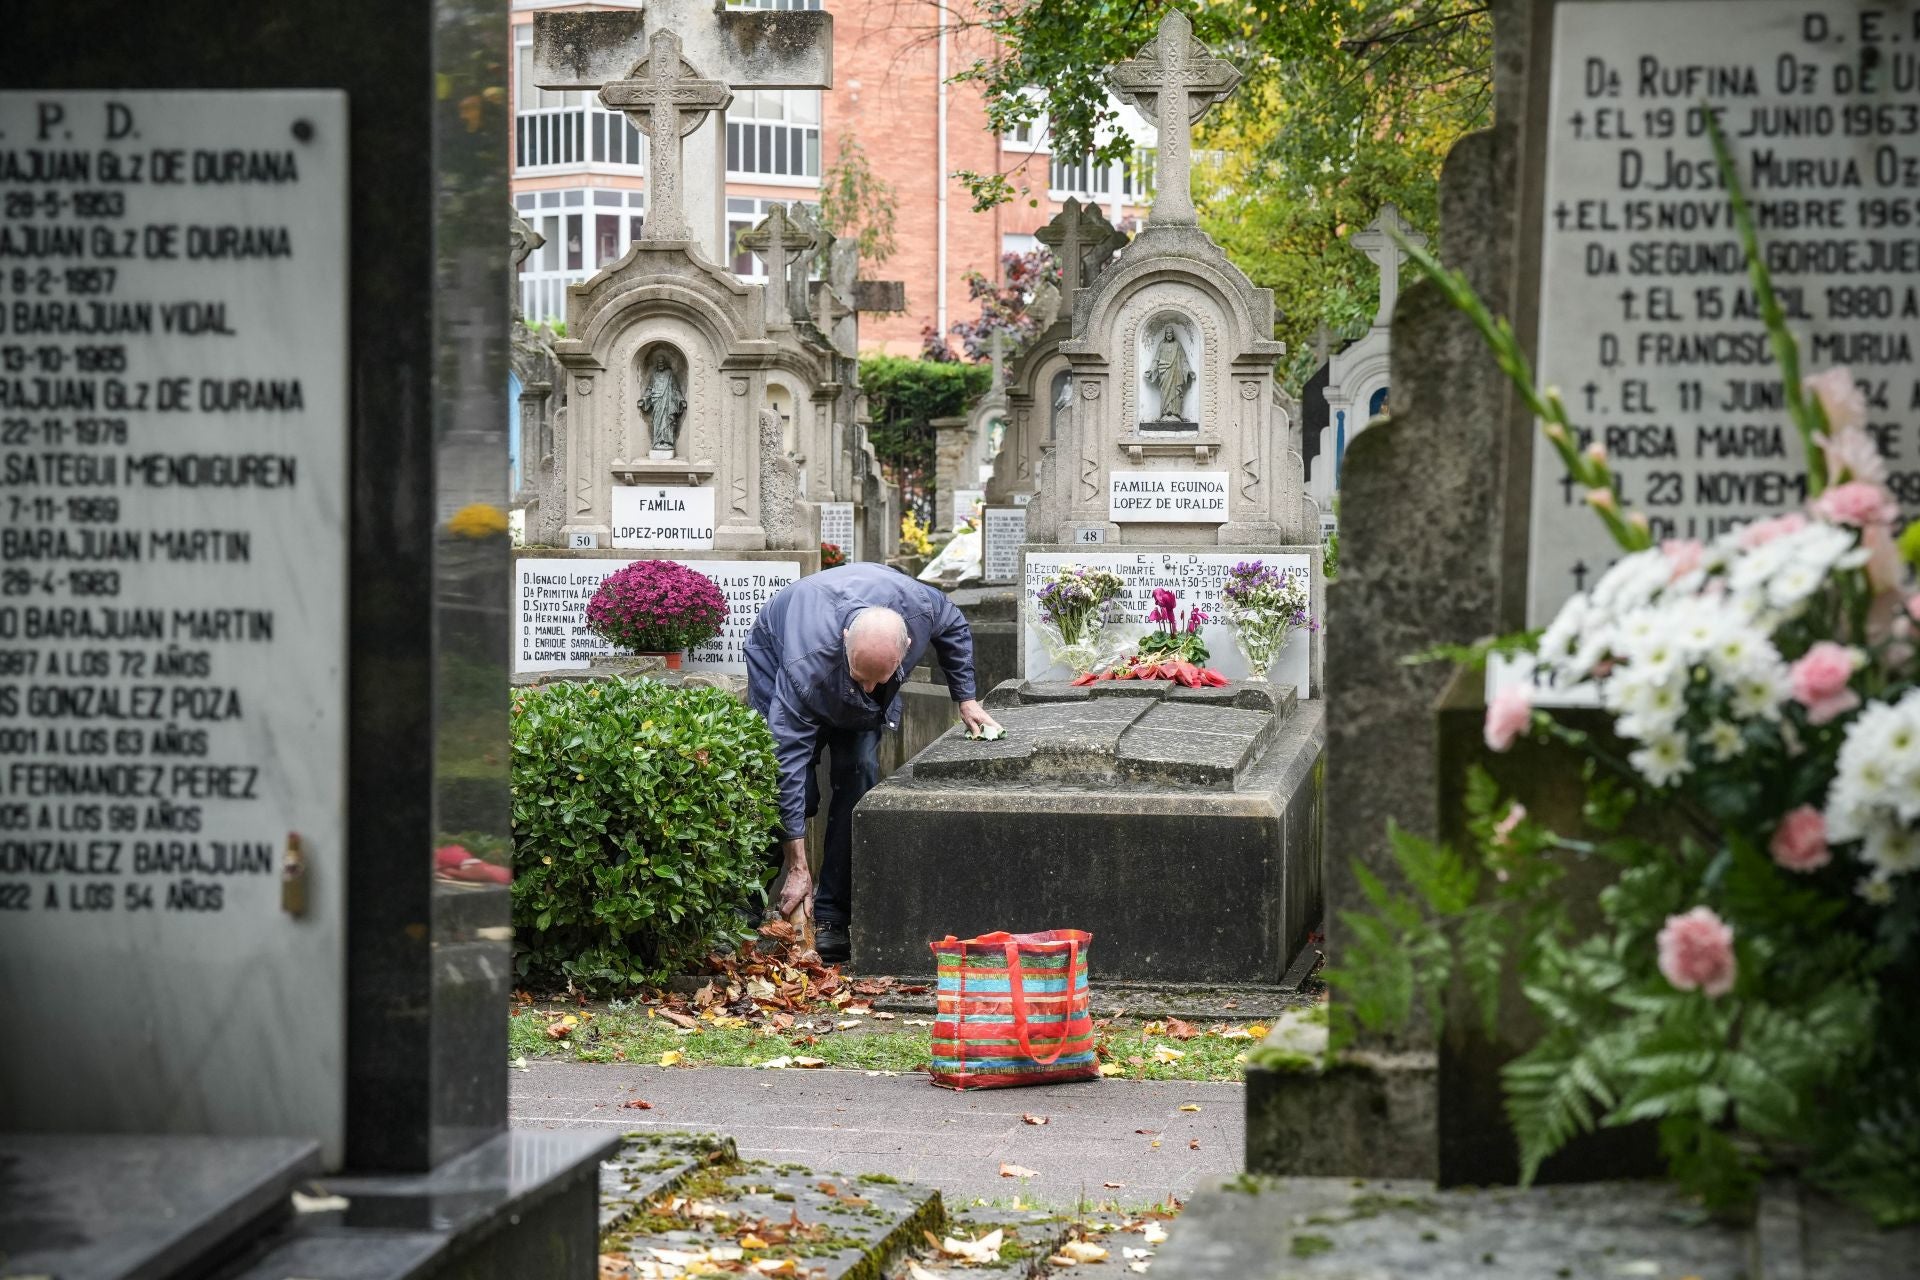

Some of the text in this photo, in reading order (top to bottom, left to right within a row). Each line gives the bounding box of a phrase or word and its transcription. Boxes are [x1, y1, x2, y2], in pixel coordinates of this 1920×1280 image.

[1639, 55, 1760, 98] RUFINA
[37, 102, 140, 141] P. D.
[1595, 108, 1633, 140] EL
[1643, 107, 1675, 139] 19
[1737, 105, 1834, 139] JUNIO
[1841, 103, 1919, 137] 1963
[193, 150, 299, 184] DURANA
[1752, 149, 1862, 190] MURUA
[1657, 200, 1846, 230] NOVIMBRE
[1857, 199, 1920, 230] 196
[186, 225, 293, 261] DURANA
[1767, 240, 1920, 275] GORDEJUE
[12, 301, 152, 336] BARAJUAN
[160, 302, 237, 337] VIDAL
[1695, 287, 1723, 321] 15
[1825, 285, 1893, 320] 1980
[1638, 334, 1776, 365] FRANCISC
[1811, 333, 1913, 365] MURUA
[200, 377, 304, 413] DURANA
[1621, 379, 1786, 414] EL 11 JUNI
[1605, 424, 1678, 460] ROSA
[1696, 424, 1787, 460] MARIA
[1113, 481, 1224, 492] FAMILIA EGUINOA
[1114, 498, 1224, 510] LOPEZ DE URALDE
[1647, 470, 1683, 506] 23
[1696, 471, 1808, 506] NOVIEM
[639, 499, 686, 512] FAMILIA
[1, 528, 251, 563] BARAJUAN MARTIN
[576, 536, 591, 547] 50
[613, 526, 713, 540] LOPEZ-PORTILLO
[1082, 531, 1097, 542] 48
[570, 573, 600, 586] LOPEZ
[723, 578, 729, 587] A
[731, 578, 749, 587] LOS
[752, 575, 766, 587] 70
[1116, 563, 1156, 575] URIARTE
[1139, 577, 1180, 588] MATURANA
[1187, 576, 1231, 588] 30-5-197
[537, 586, 579, 599] PRIMITIVA
[733, 591, 751, 600] LOS
[753, 589, 766, 600] 64
[733, 604, 751, 614] LOS
[25, 606, 275, 642] BARAJUAN MARTIN
[535, 613, 576, 624] HERMINIA
[733, 617, 751, 626] LOS
[535, 626, 566, 636] MANUEL
[729, 629, 735, 638] A
[738, 629, 750, 638] LO
[46, 652, 60, 678] A
[65, 651, 110, 679] LOS
[118, 650, 147, 679] 72
[153, 643, 211, 680] AÑOS
[534, 651, 566, 661] CARMEN
[688, 653, 724, 663] 11-4-2014
[728, 653, 734, 663] A
[535, 638, 567, 649] ENRIQUE
[570, 638, 609, 649] SARRALDE
[727, 641, 733, 651] A
[27, 686, 243, 722] GONZALEZ POZA
[46, 728, 60, 756] A
[64, 727, 109, 757] LOS
[151, 720, 209, 758] AÑOS
[9, 762, 260, 800] FERNANDEZ PEREZ
[37, 804, 51, 831] A
[58, 803, 102, 832] LOS
[144, 798, 203, 833] AÑOS
[133, 841, 274, 876] BARAJUAN
[44, 883, 60, 911] A
[69, 882, 115, 912] LOS
[165, 877, 225, 912] AÑOS
